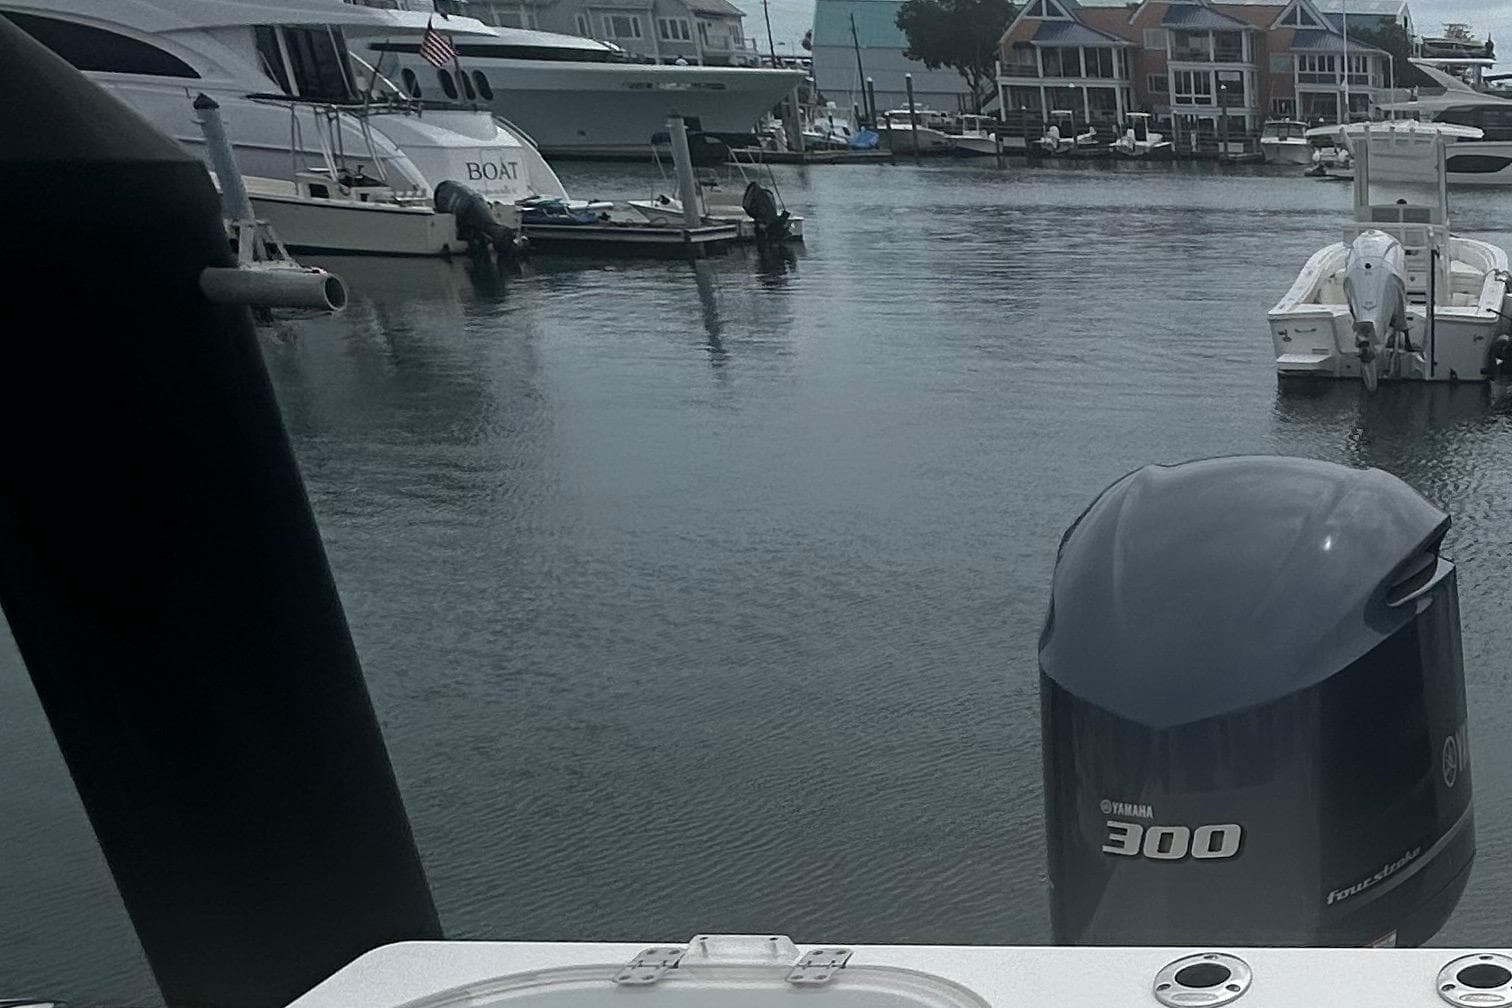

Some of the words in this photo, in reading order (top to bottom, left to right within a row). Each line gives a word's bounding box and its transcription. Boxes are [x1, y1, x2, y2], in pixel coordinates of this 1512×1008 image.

[466, 162, 518, 180] BOAT
[1112, 802, 1154, 819] YAMAHA
[1102, 820, 1242, 860] 300
